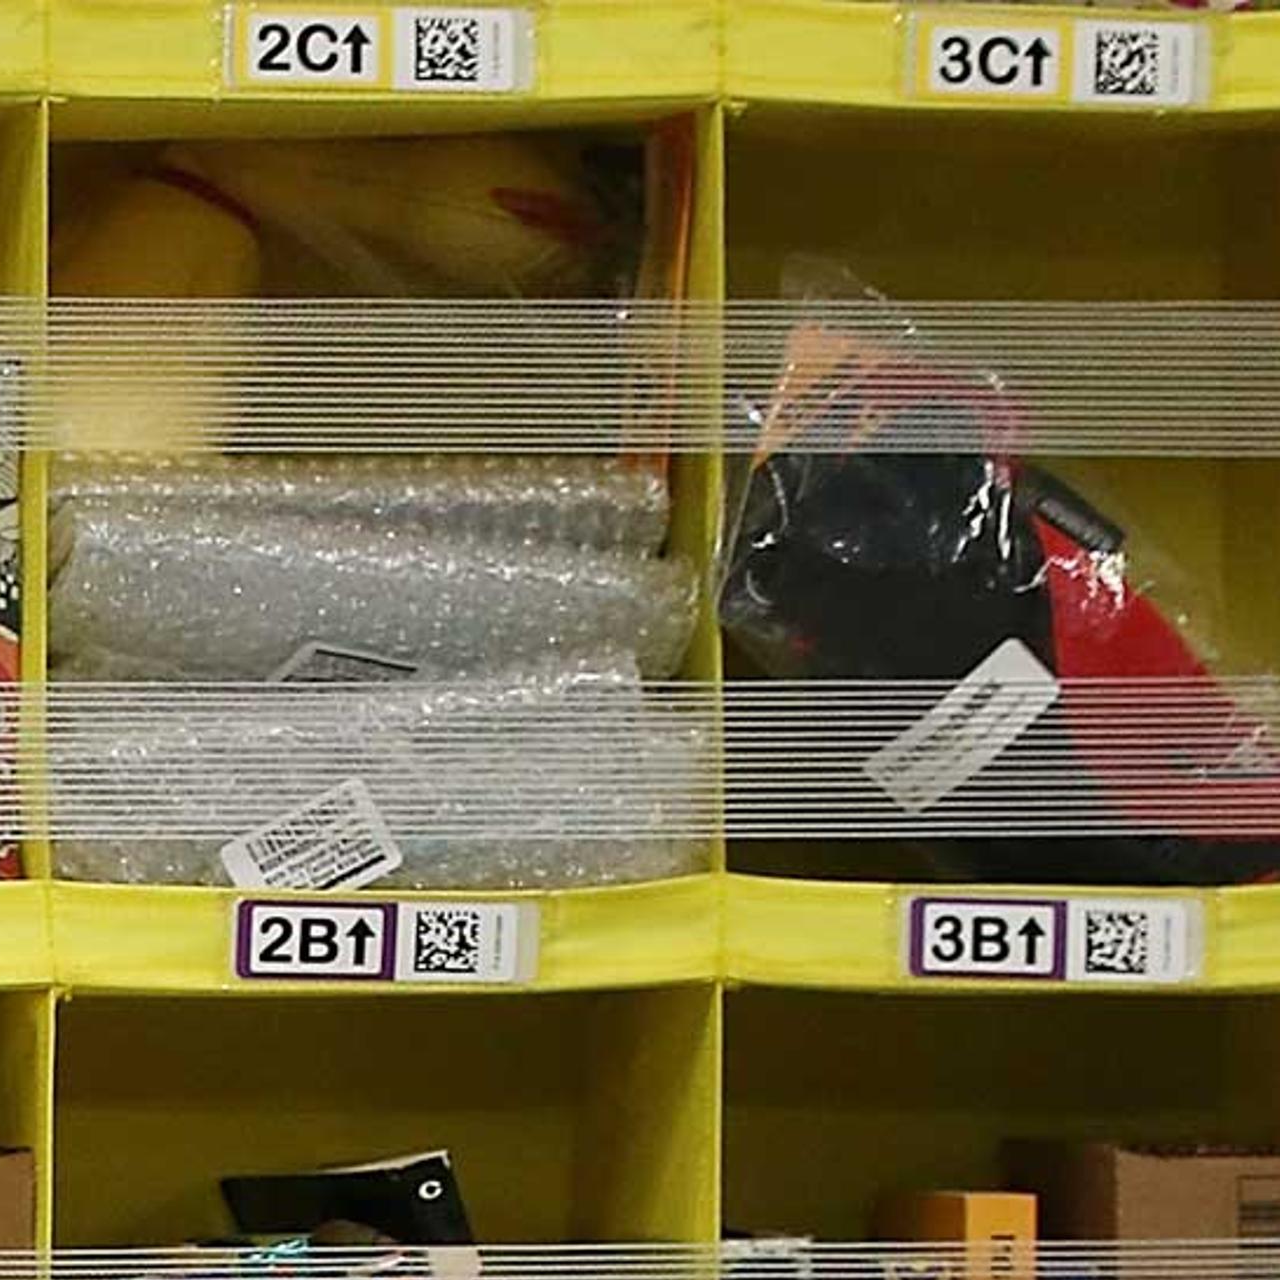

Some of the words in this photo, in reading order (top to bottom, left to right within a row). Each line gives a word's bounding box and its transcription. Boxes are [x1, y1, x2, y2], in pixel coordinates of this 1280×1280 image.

[257, 23, 339, 72] 2C
[940, 36, 1019, 85] 3C
[258, 916, 339, 965] 2B
[931, 915, 1010, 963] 3B
